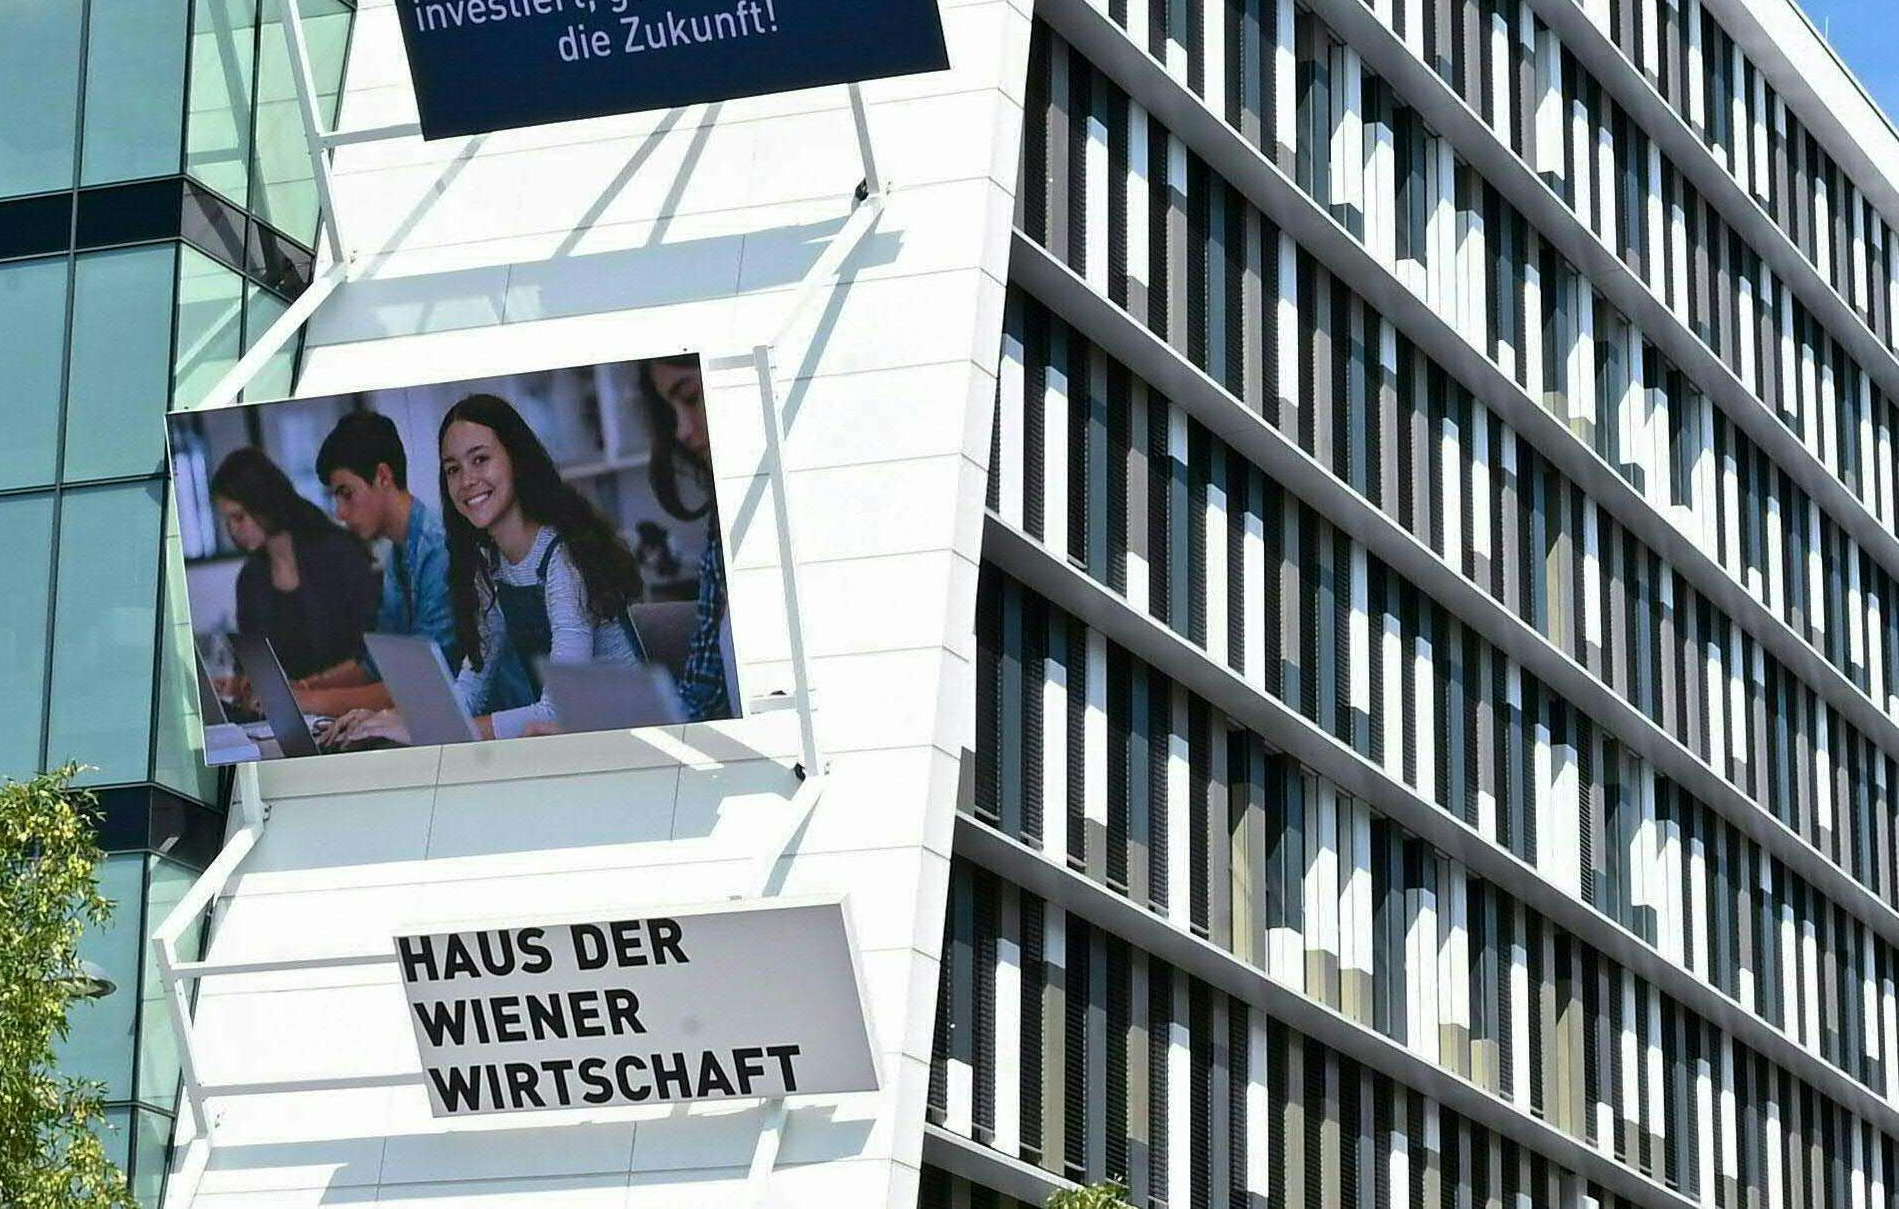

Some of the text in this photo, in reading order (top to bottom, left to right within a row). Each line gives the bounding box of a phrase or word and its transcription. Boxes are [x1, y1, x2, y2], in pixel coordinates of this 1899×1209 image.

[558, 24, 611, 62] die
[399, 917, 690, 982] HAUS DER
[413, 988, 647, 1047] WIENER
[428, 1044, 801, 1112] WIRTSCHAFT
